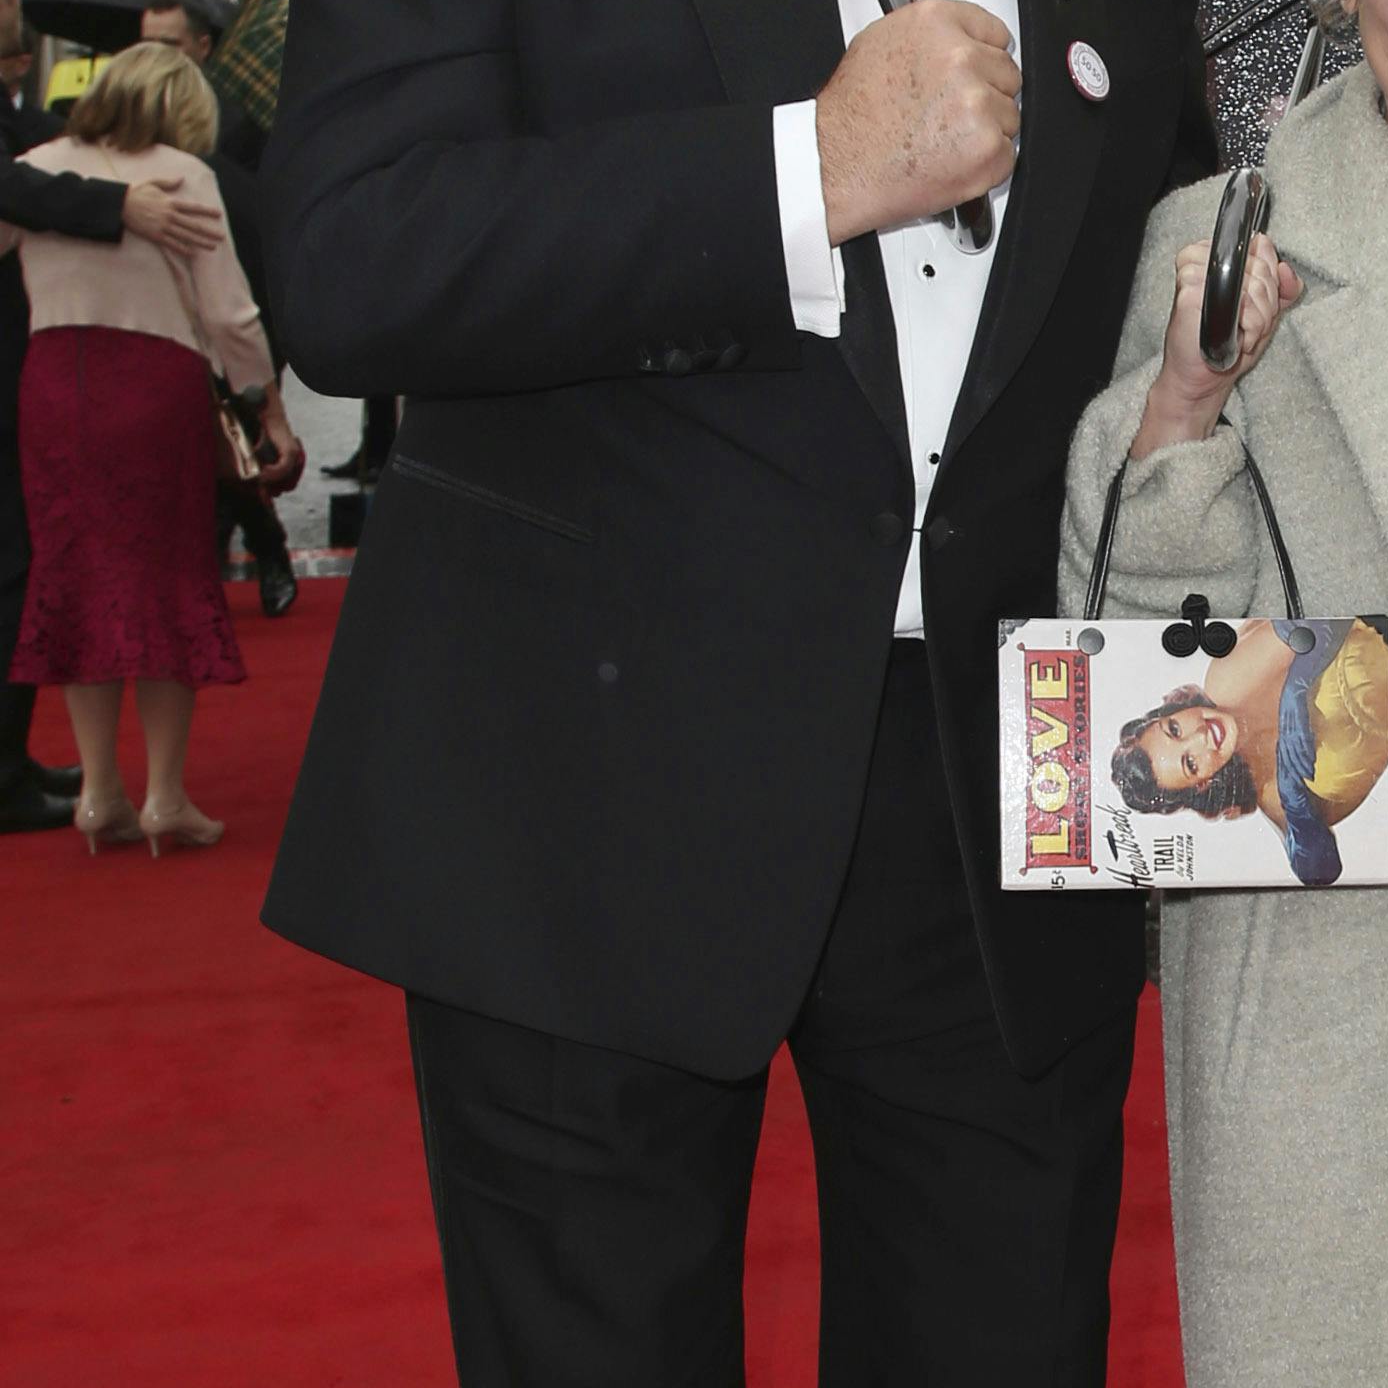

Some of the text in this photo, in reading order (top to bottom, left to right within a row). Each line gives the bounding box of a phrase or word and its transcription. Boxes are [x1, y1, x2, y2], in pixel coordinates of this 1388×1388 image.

[1073, 654, 1089, 765] STORIES
[1030, 656, 1071, 858] LOVE
[1154, 835, 1175, 873] TRAIL
[1175, 834, 1185, 863] VELDA
[1185, 833, 1195, 882] JOHNSTON
